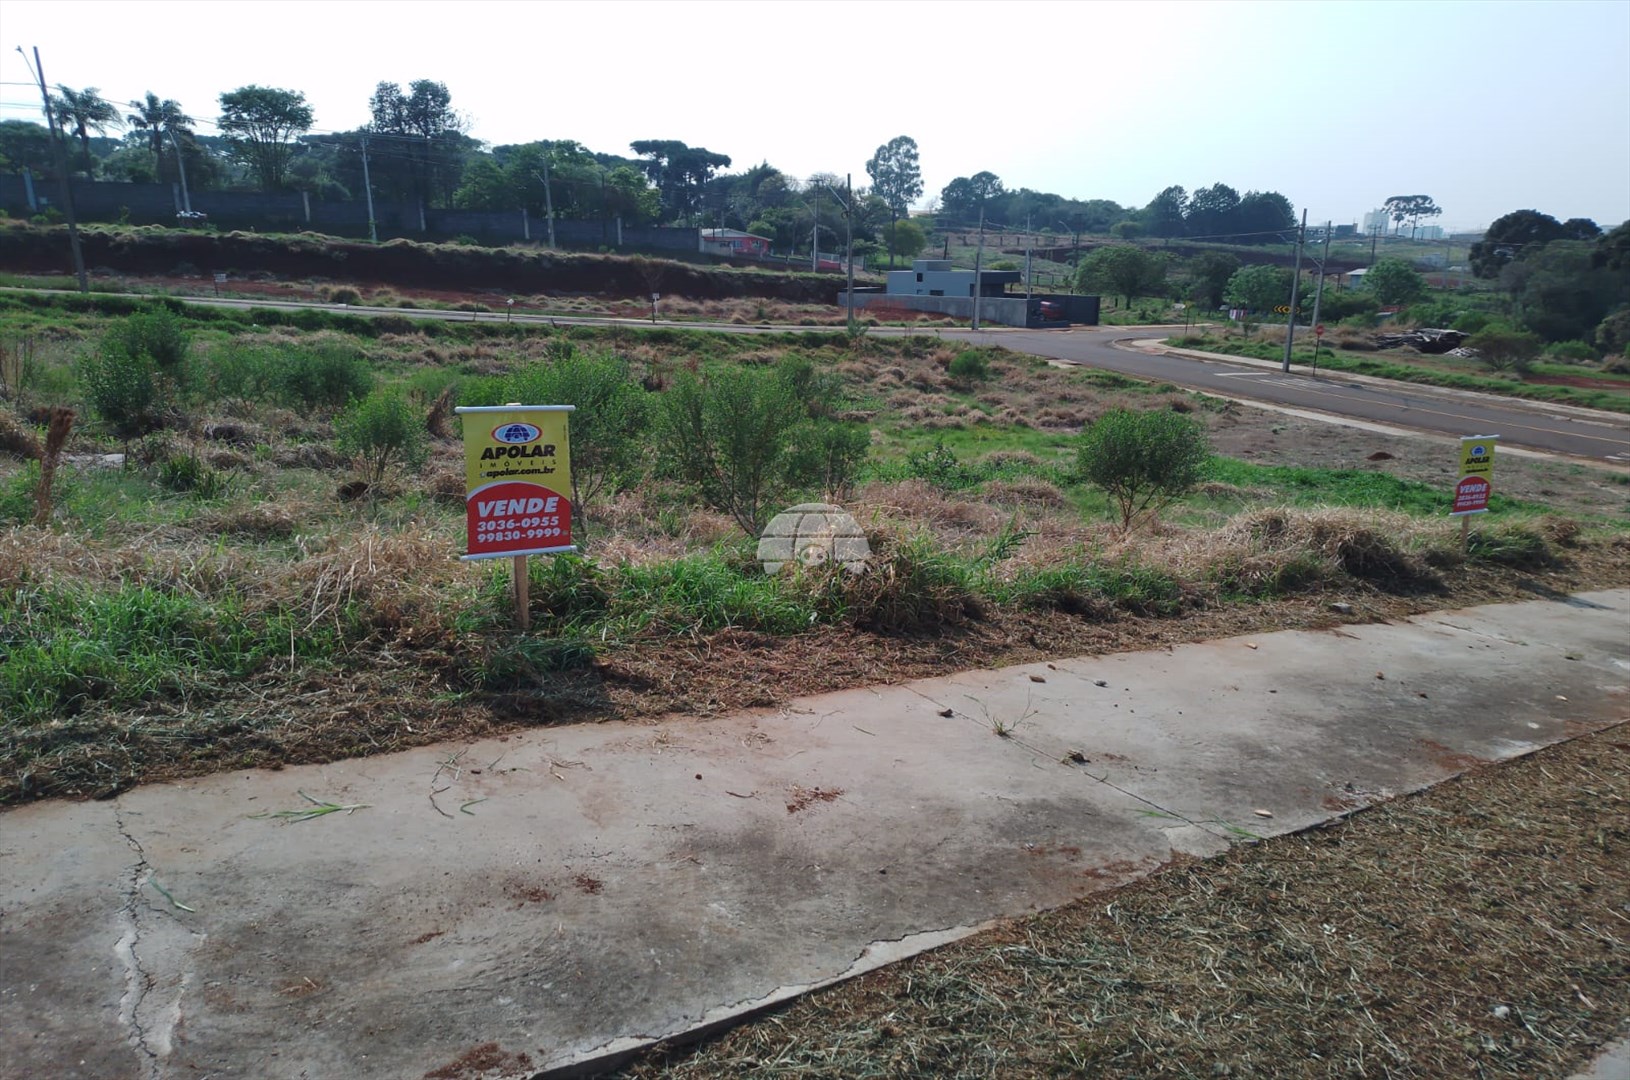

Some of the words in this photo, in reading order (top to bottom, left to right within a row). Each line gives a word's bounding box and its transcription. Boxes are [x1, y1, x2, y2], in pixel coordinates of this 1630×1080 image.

[481, 444, 556, 460] APOLAR
[486, 466, 556, 479] apolar.com.br
[1460, 483, 1488, 493] VENDE
[477, 497, 560, 518] VENDE
[477, 516, 559, 532] 3036-0955
[477, 527, 561, 543] 99830-9999
